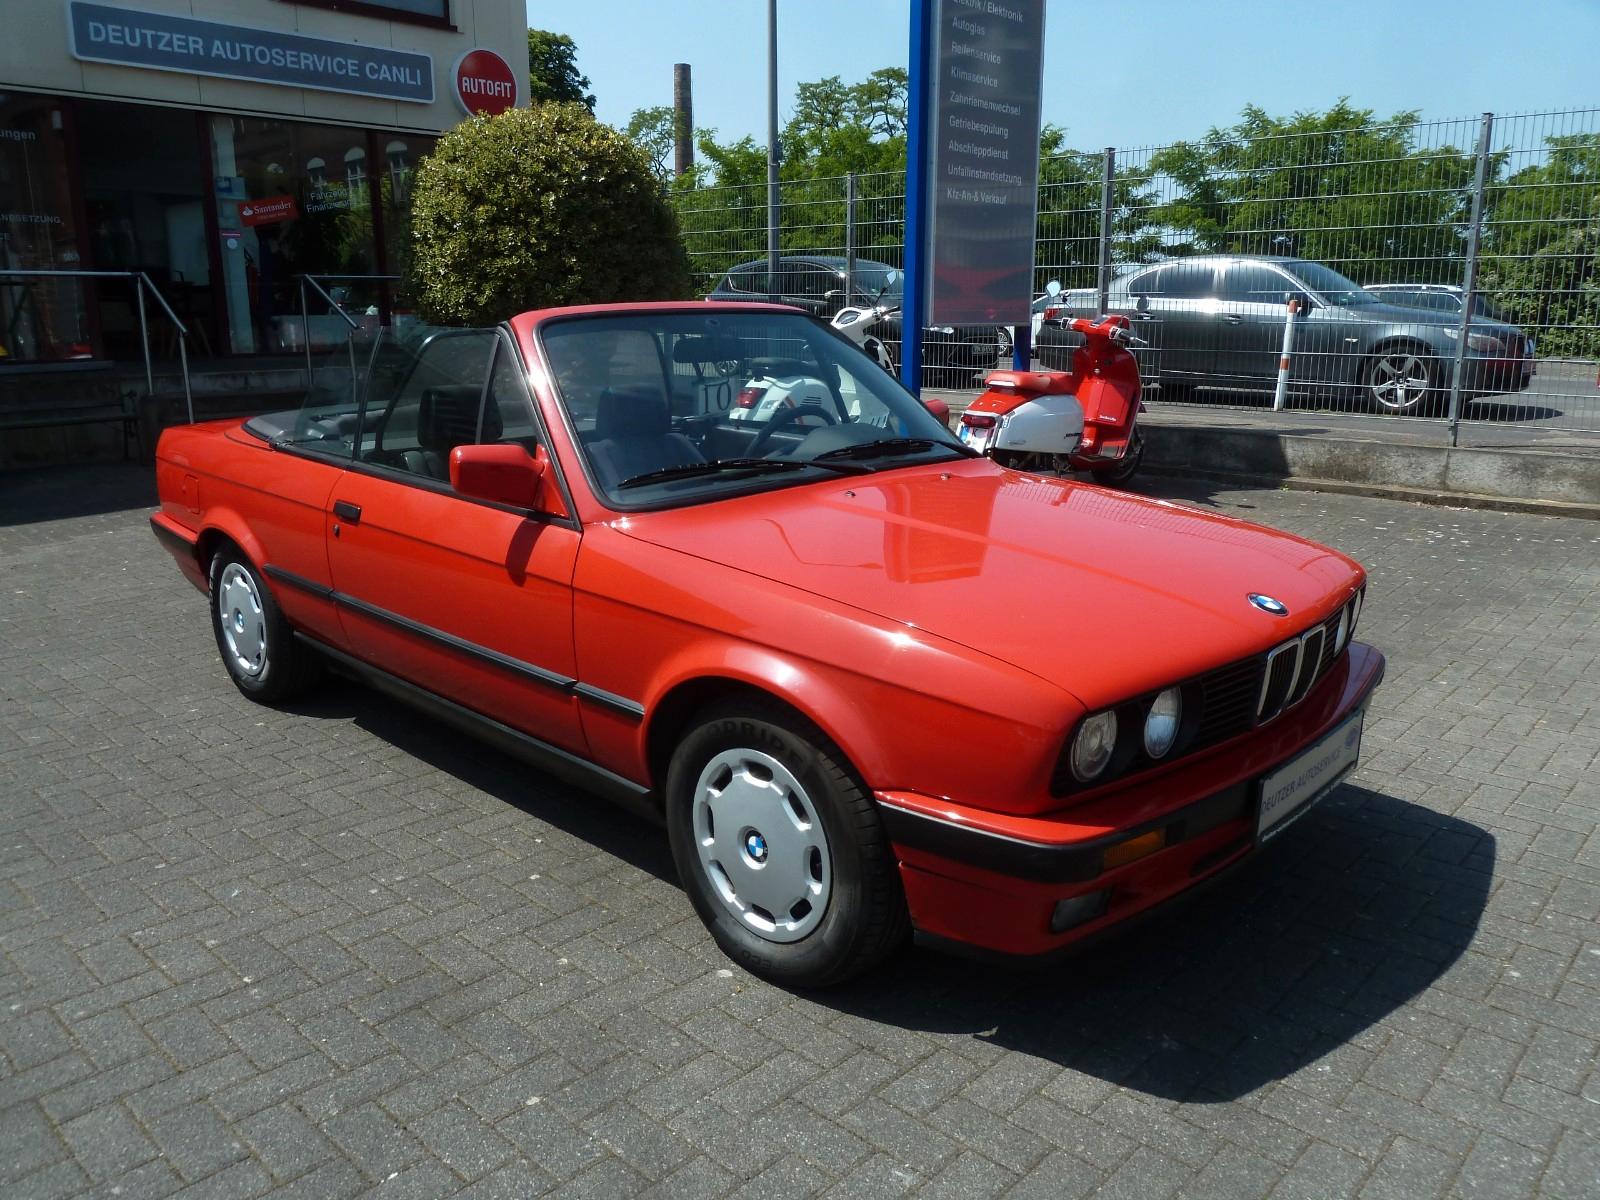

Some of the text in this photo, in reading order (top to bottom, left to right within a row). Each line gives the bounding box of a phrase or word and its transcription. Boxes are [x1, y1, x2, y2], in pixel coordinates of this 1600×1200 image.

[987, 2, 1023, 22] Elektronik
[952, 16, 985, 35] Autoglas
[88, 21, 421, 85] DEUTZER AUTOSERVICE CANLI
[951, 41, 1001, 64] Reifenservice
[462, 76, 511, 98] AUTOFIT
[951, 66, 998, 88] Klimaservice
[950, 91, 1021, 115] Zahnriemenwechsel
[948, 140, 1008, 159] Abschleppdienst
[947, 164, 1022, 186] Unfallinstandsetzung
[254, 199, 292, 215] Santander
[981, 192, 1007, 205] Verkauf
